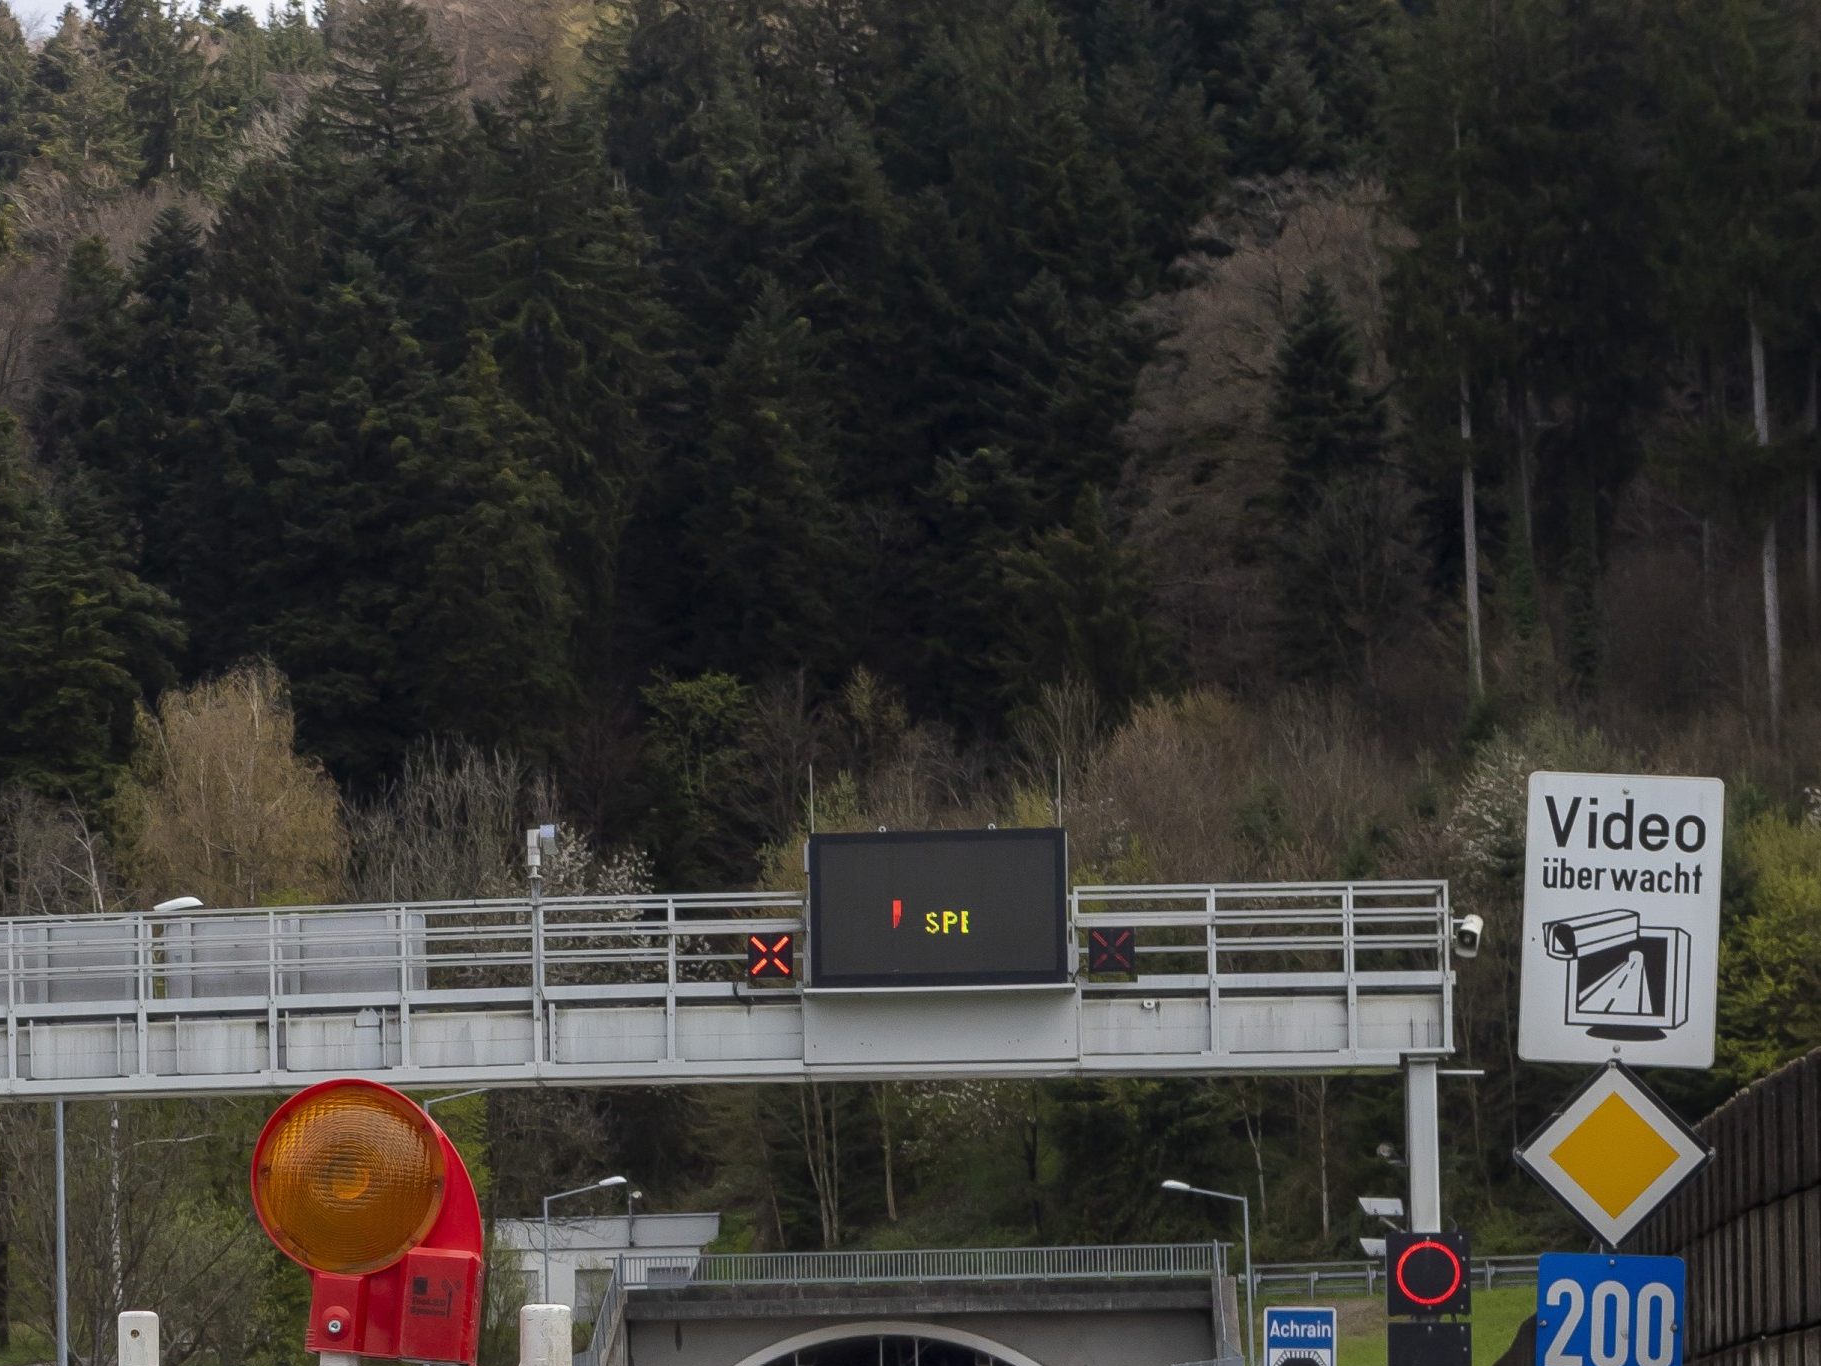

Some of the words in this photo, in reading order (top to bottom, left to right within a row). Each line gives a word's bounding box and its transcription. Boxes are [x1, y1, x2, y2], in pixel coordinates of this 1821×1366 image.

[1545, 795, 1707, 853] Video
[1542, 857, 1703, 894] überwacht
[1269, 1319, 1332, 1338] Achrain
